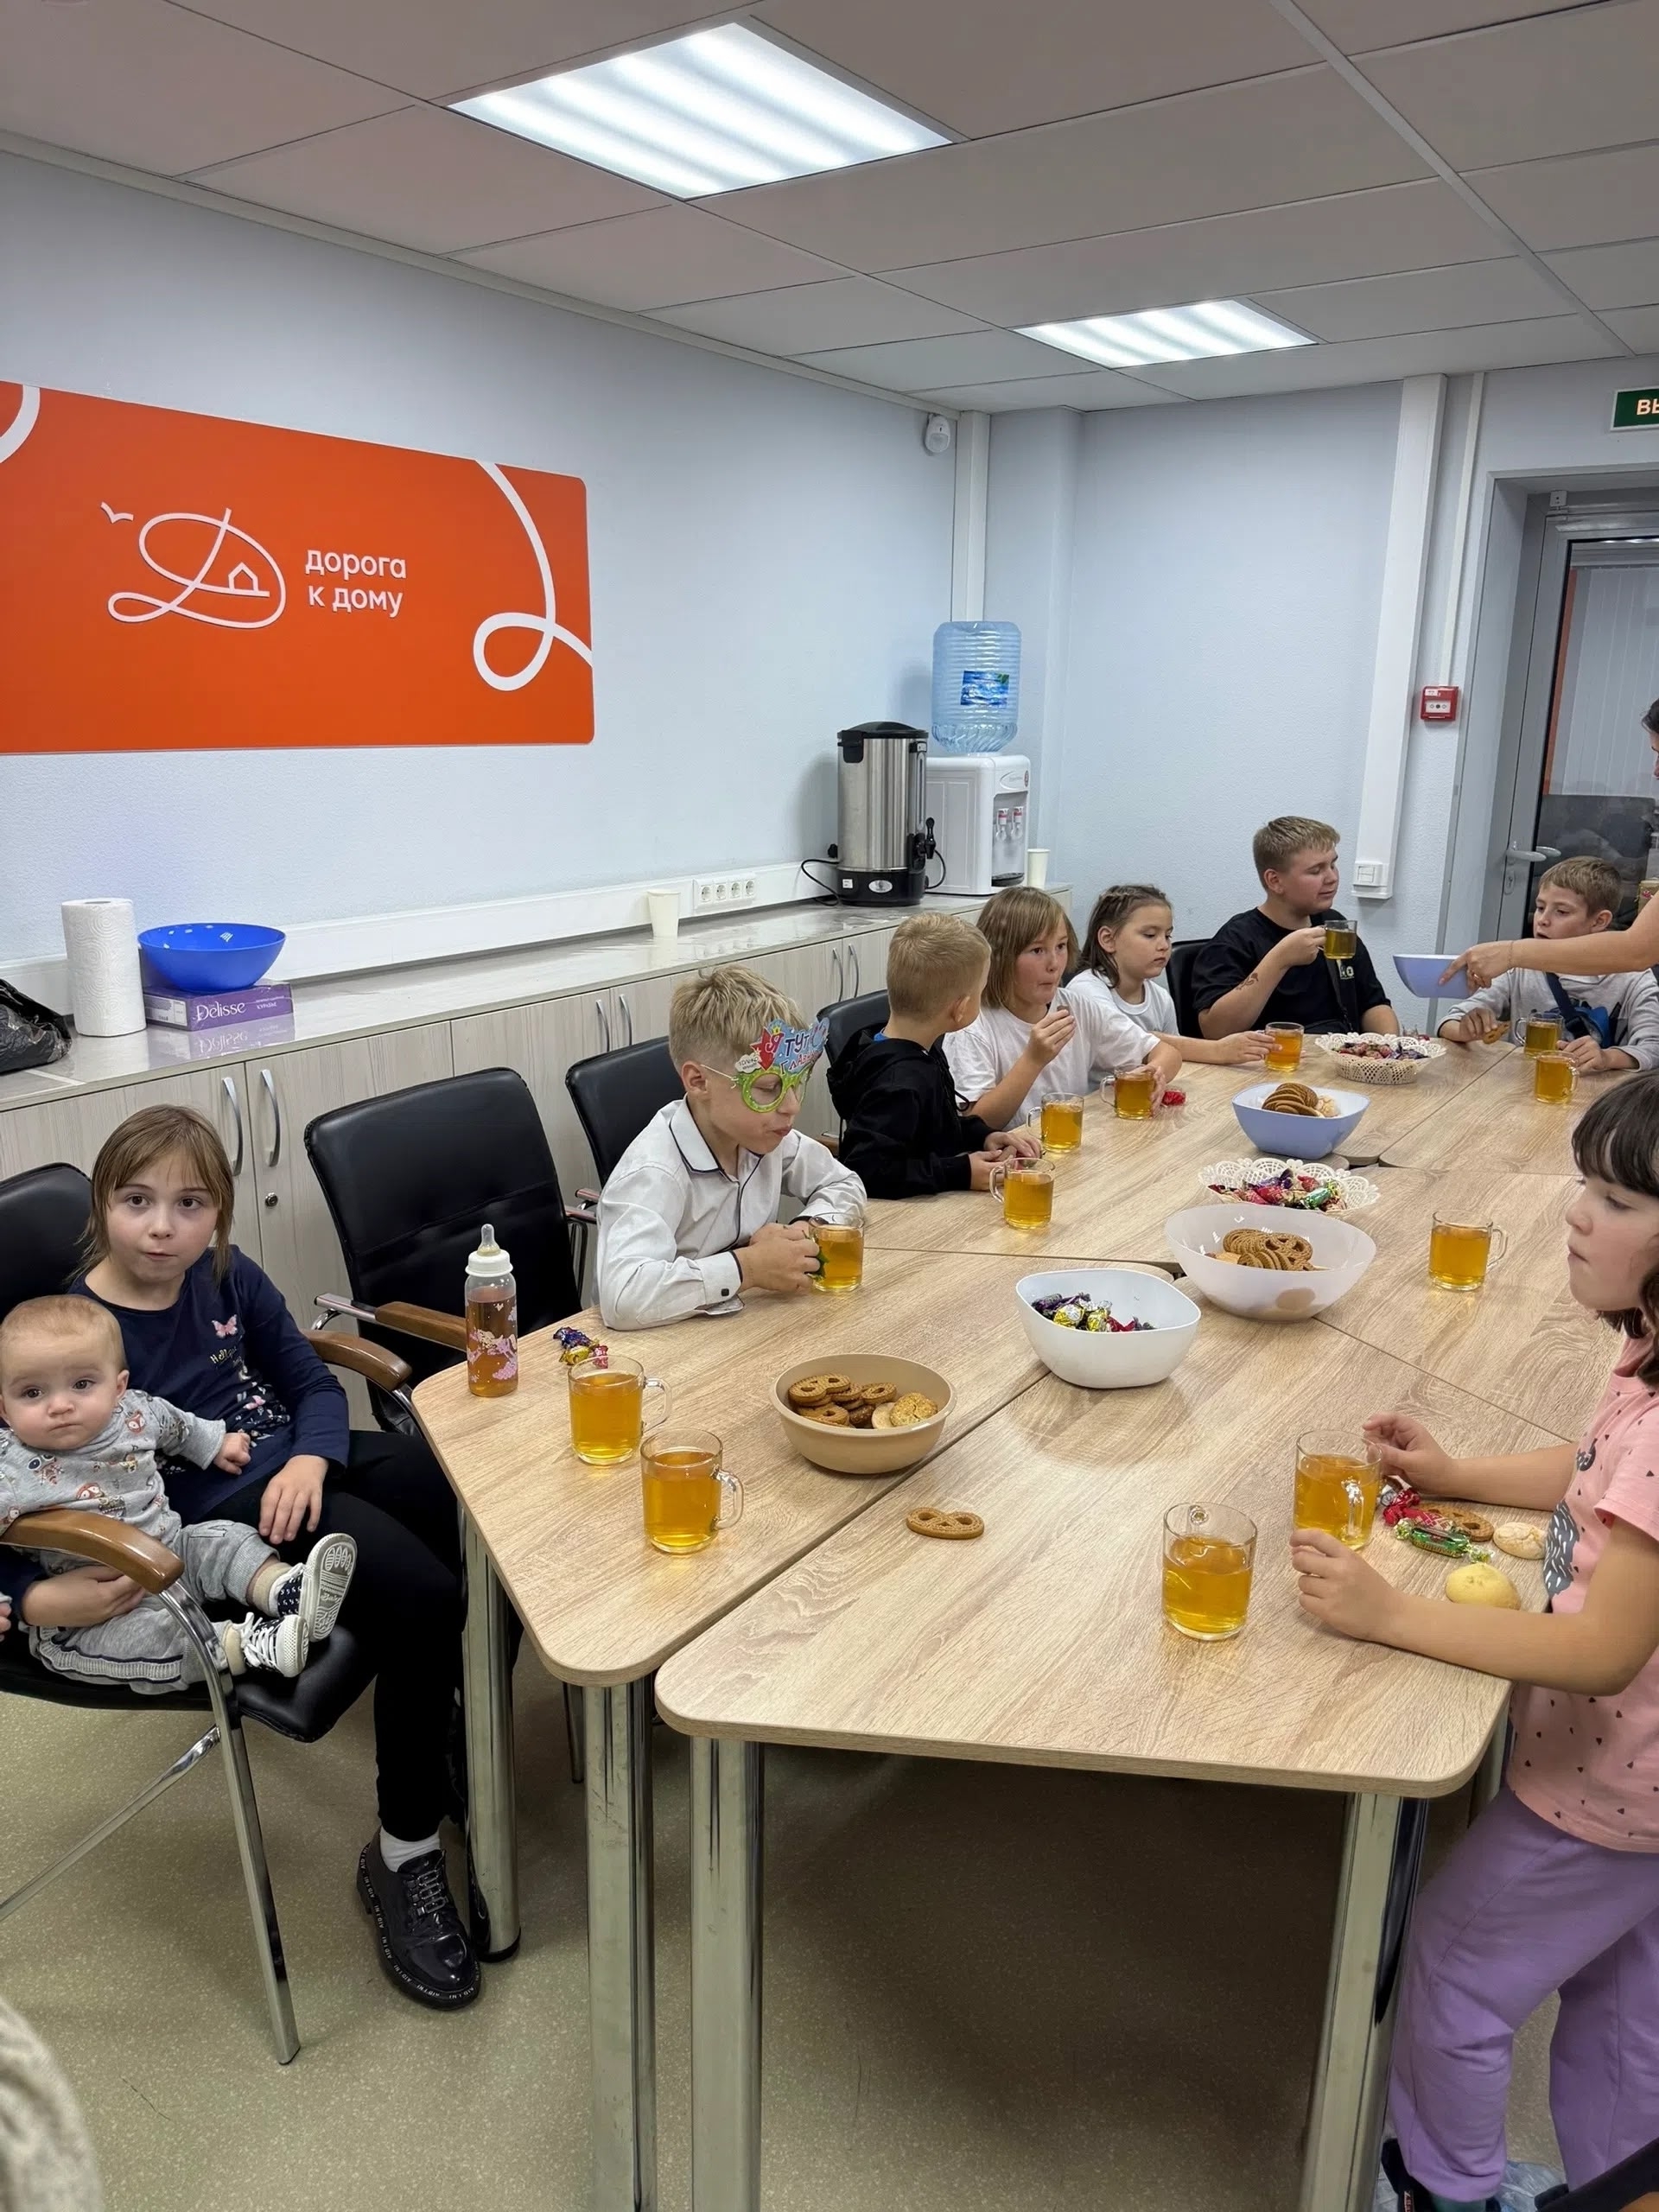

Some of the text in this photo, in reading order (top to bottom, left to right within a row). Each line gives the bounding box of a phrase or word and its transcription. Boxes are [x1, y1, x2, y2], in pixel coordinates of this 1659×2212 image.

[305, 550, 407, 582] дорога
[308, 585, 404, 618] к дому
[196, 1001, 247, 1022] Delisse
[766, 1033, 784, 1052] Я
